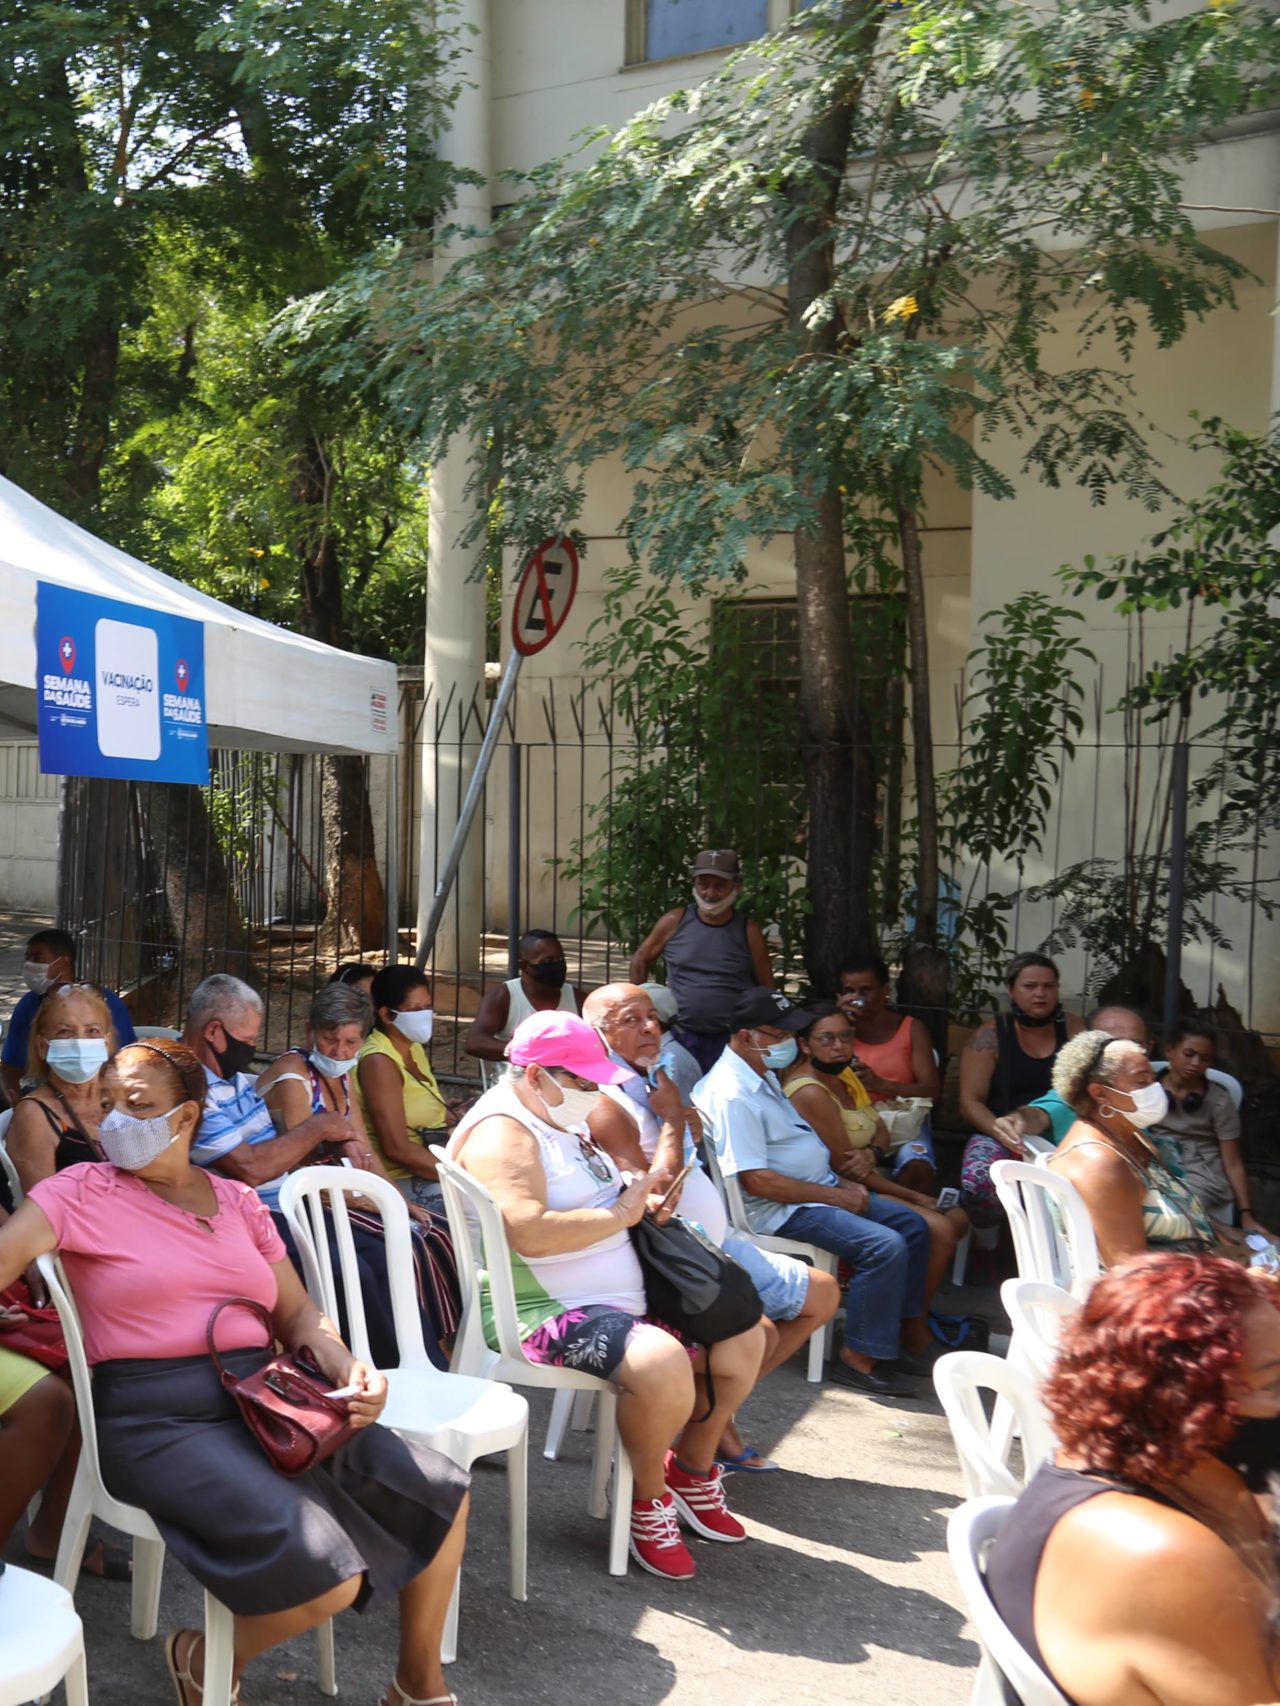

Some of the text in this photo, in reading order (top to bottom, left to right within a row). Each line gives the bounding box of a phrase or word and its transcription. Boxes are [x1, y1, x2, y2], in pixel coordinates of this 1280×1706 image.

[43, 674, 91, 695] SEMANA
[101, 671, 153, 694] VACINAÇÃO
[163, 693, 202, 711] SEMANA
